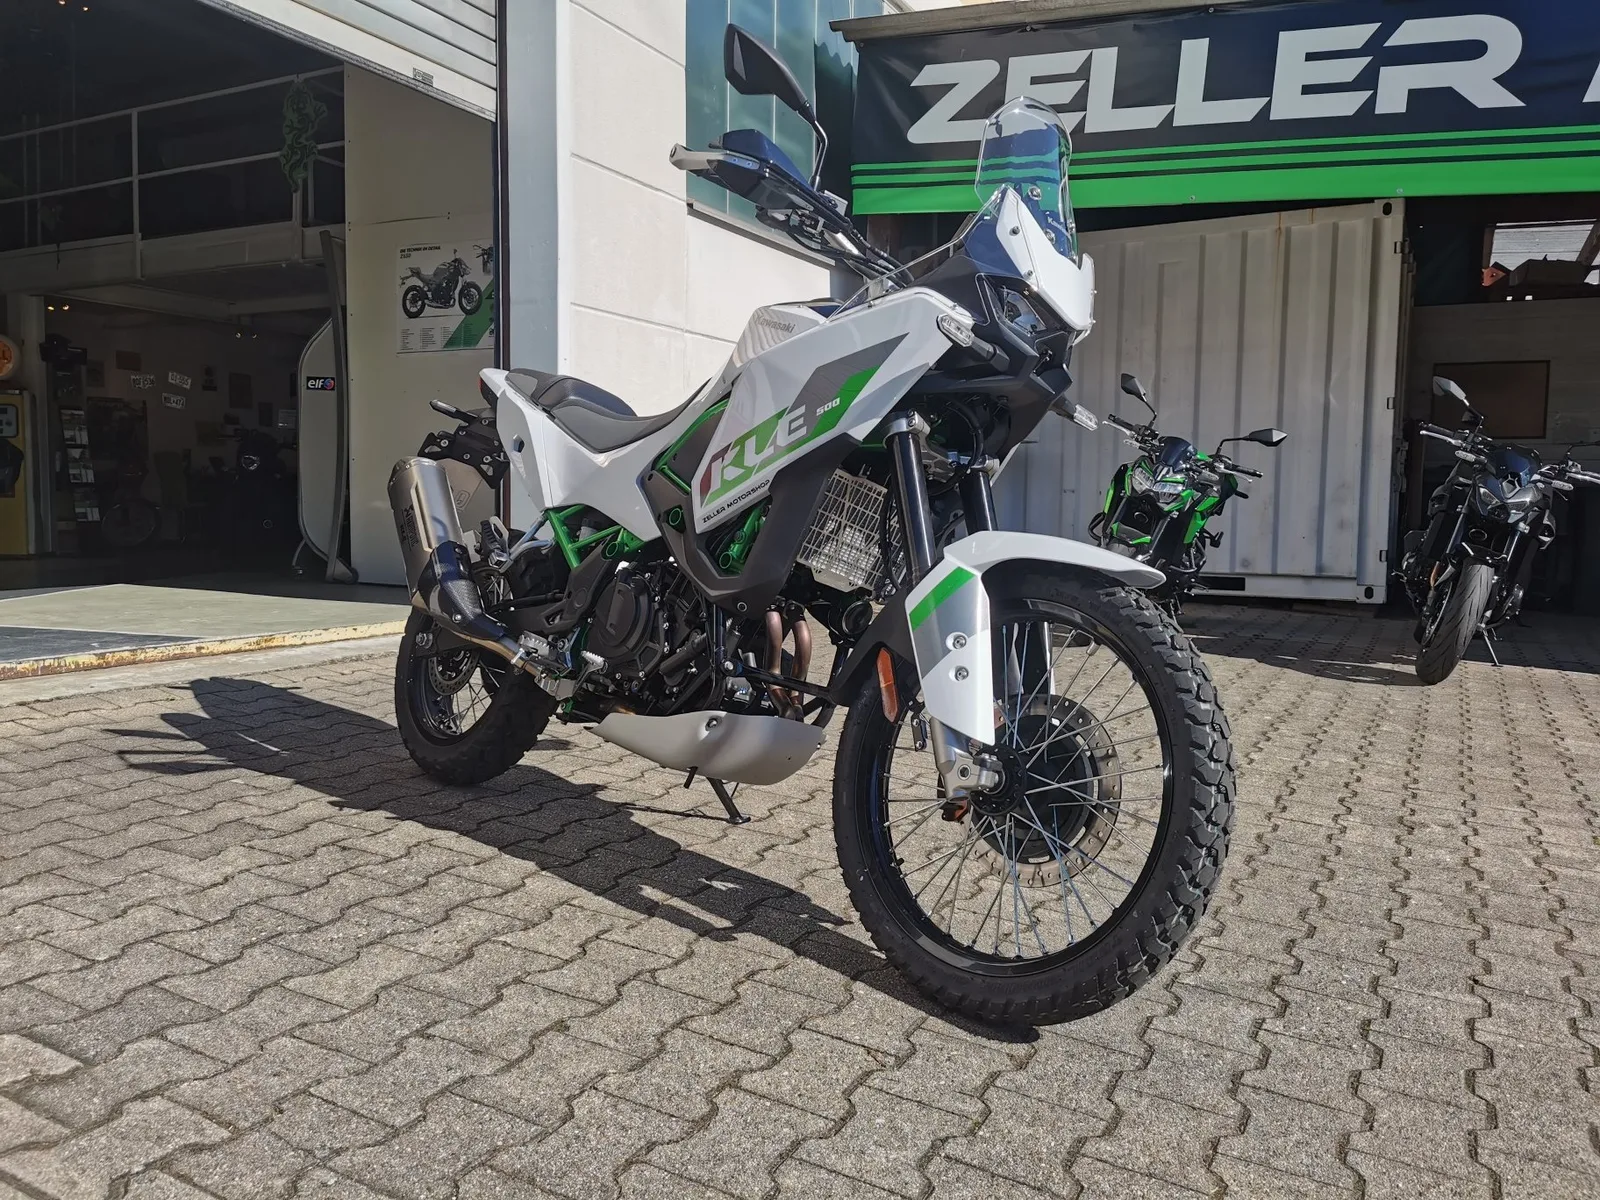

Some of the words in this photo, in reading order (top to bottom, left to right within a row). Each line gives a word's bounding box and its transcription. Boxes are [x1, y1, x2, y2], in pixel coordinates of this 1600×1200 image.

[906, 13, 1527, 144] ZELLER
[756, 315, 797, 334] Kawasaki
[307, 378, 325, 389] elf
[709, 404, 807, 489] KLE
[816, 396, 840, 416] 500
[702, 503, 727, 524] ZELLER
[726, 478, 771, 510] MOTORSHOP
